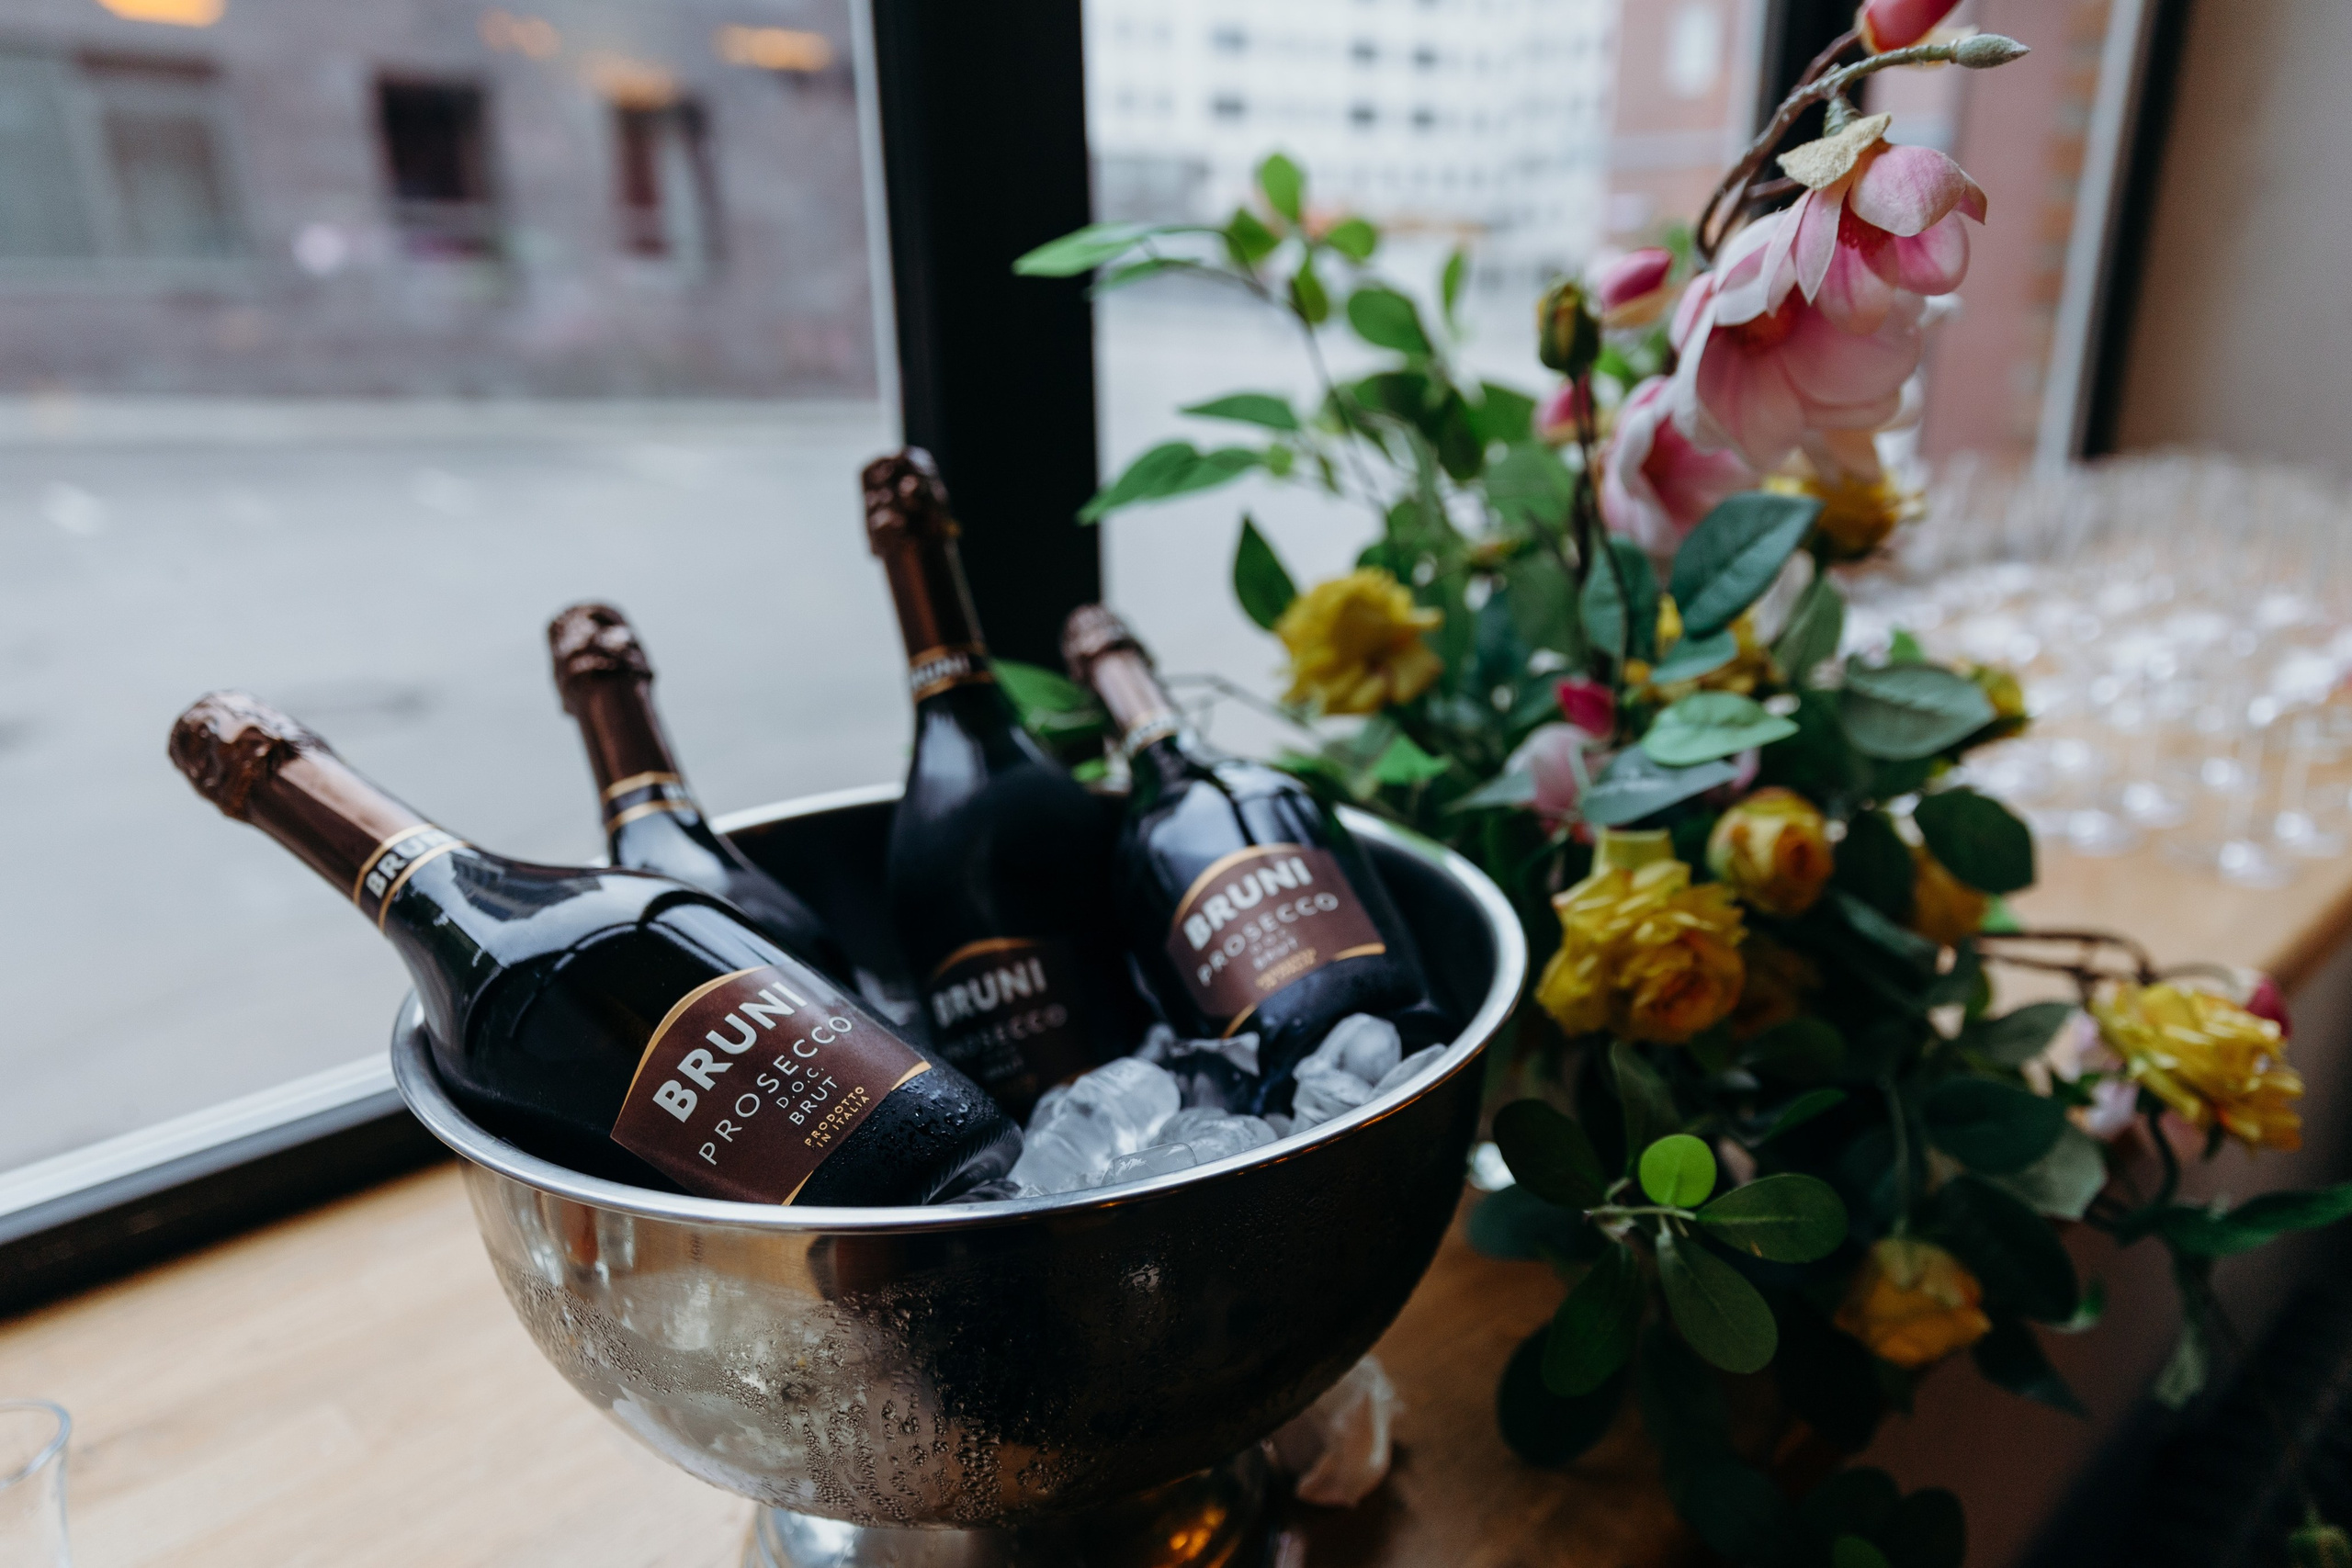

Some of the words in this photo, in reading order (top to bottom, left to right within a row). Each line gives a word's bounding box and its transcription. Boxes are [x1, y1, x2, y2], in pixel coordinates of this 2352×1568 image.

[366, 829, 450, 899] BRU
[1183, 856, 1314, 952] BRUNI
[1197, 892, 1339, 987] PROSECCO
[652, 982, 808, 1123] BRUNI
[775, 1066, 824, 1109] D.O.C.
[698, 1016, 854, 1166] PROSECCO
[789, 1076, 838, 1126] BRUT
[804, 1087, 865, 1146] PRODOTTO
[816, 1133, 831, 1147] IN
[832, 1095, 870, 1131] ITALIA
